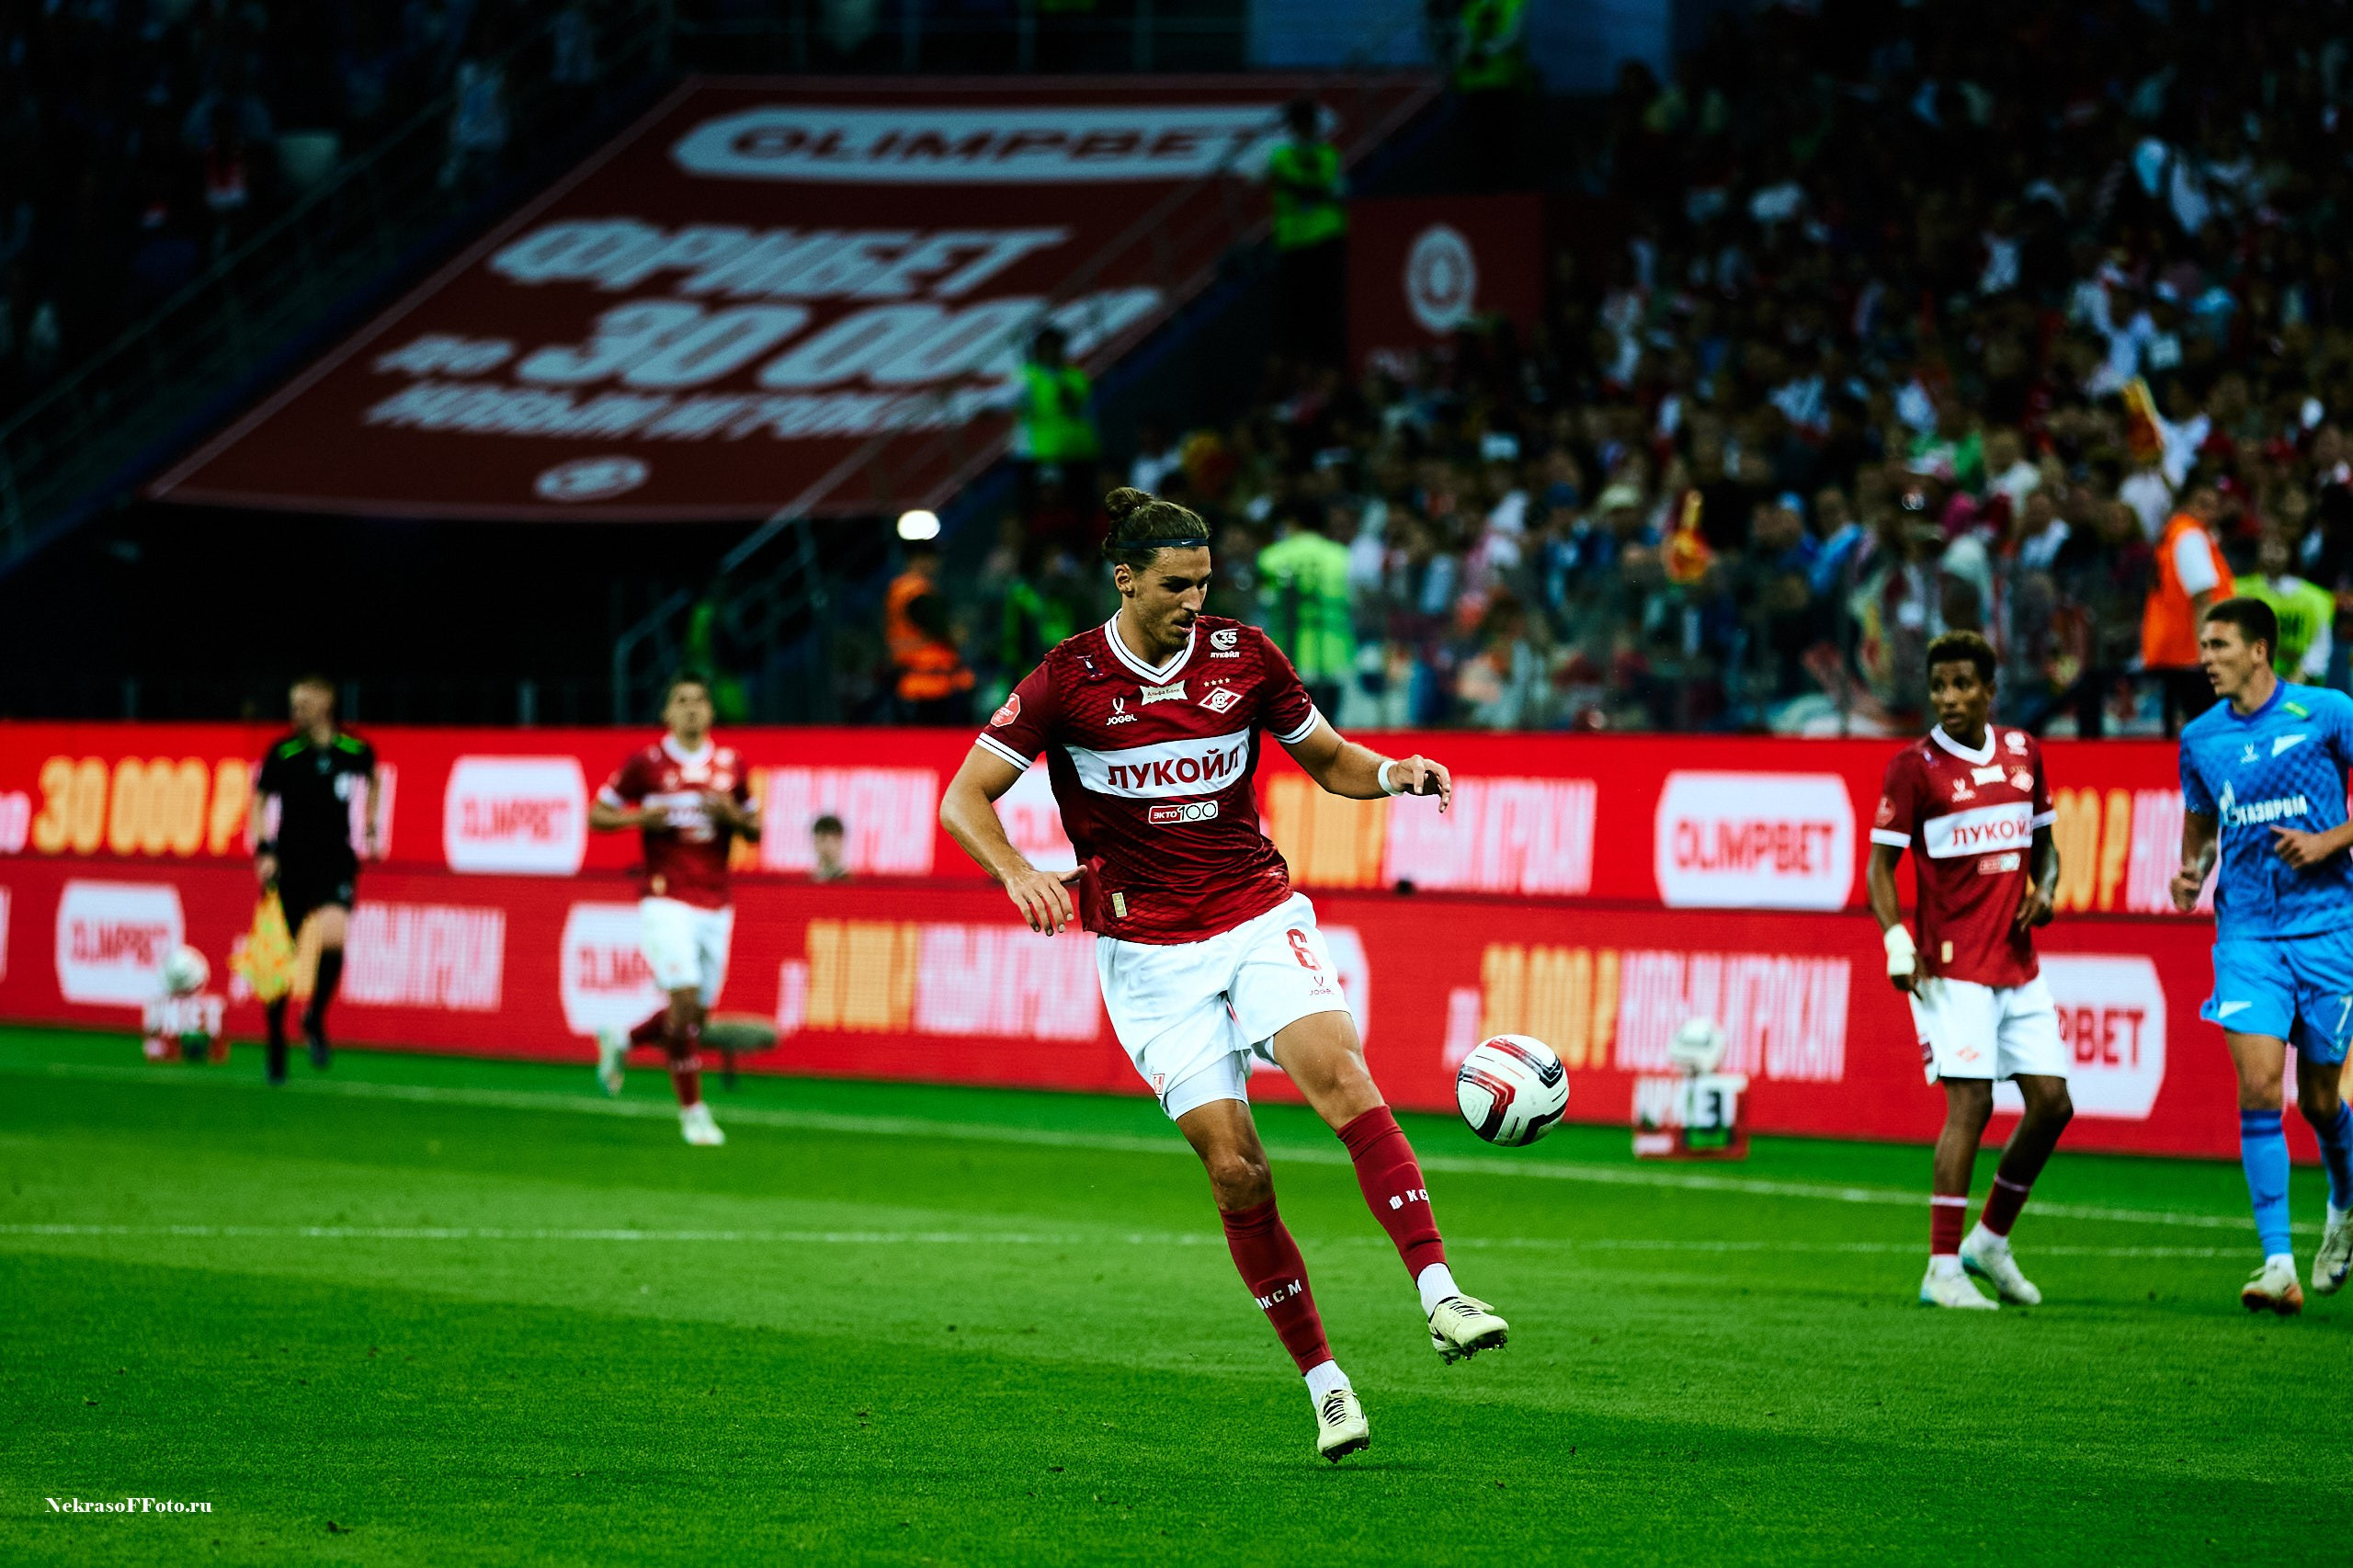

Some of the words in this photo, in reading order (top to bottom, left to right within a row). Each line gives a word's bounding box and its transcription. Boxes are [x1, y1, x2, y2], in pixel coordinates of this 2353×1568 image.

[1219, 631, 1237, 644] 35
[1108, 745, 1240, 790] ЛУКОЙЛ
[1153, 811, 1178, 820] ЭКТО
[1178, 802, 1217, 821] 100
[1674, 816, 1835, 879] OLIMPBET
[1286, 928, 1322, 971] 6
[2337, 995, 2353, 1034] 7
